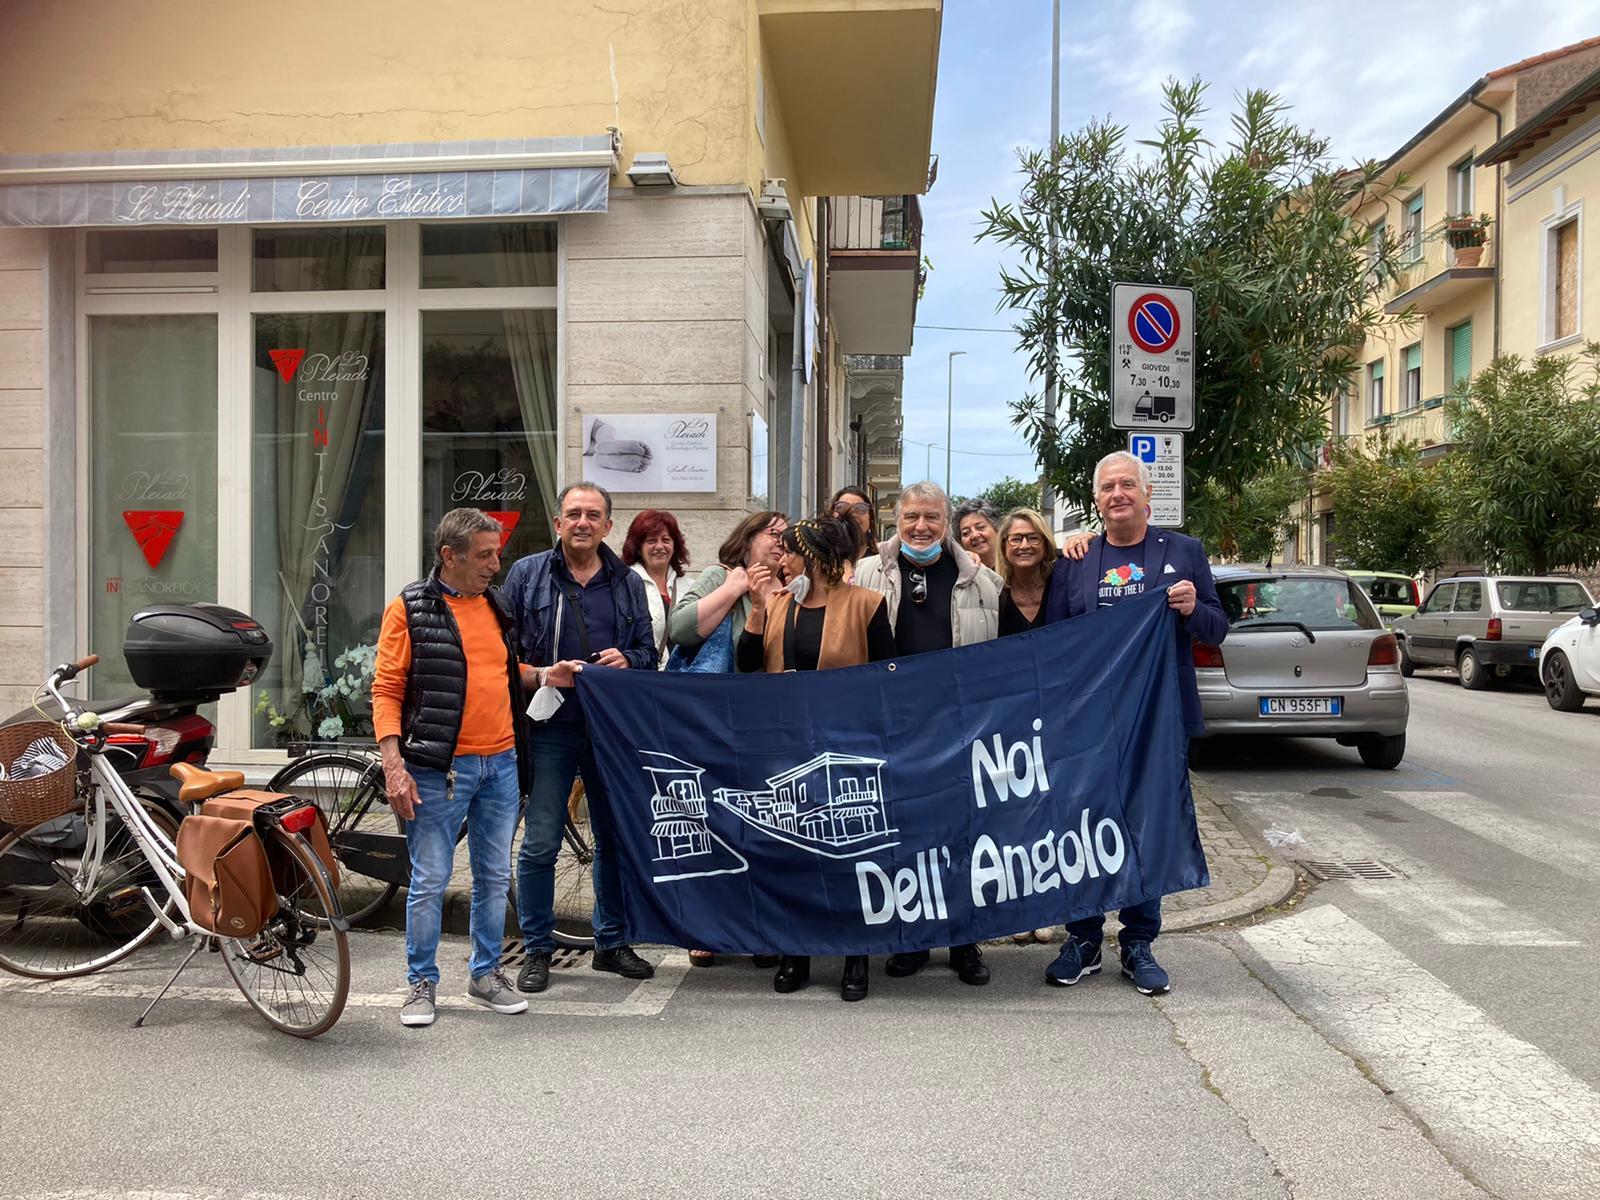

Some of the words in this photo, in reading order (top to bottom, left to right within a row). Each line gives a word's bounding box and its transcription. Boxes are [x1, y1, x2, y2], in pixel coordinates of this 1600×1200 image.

[116, 185, 158, 221] Le
[154, 185, 251, 220] Pleiadi
[296, 181, 369, 216] Centro
[376, 178, 465, 214] Estetico
[300, 353, 370, 382] Pleiadi
[298, 389, 338, 401] Centro
[1138, 440, 1151, 457] P
[450, 470, 527, 502] Pleiadi
[1113, 586, 1122, 597] OF
[1124, 584, 1138, 596] THE
[1270, 699, 1286, 712] CN
[1290, 699, 1330, 712] 953FT
[971, 718, 1049, 808] Noi
[855, 845, 951, 925] Dell'
[970, 807, 1125, 908] Angolo
